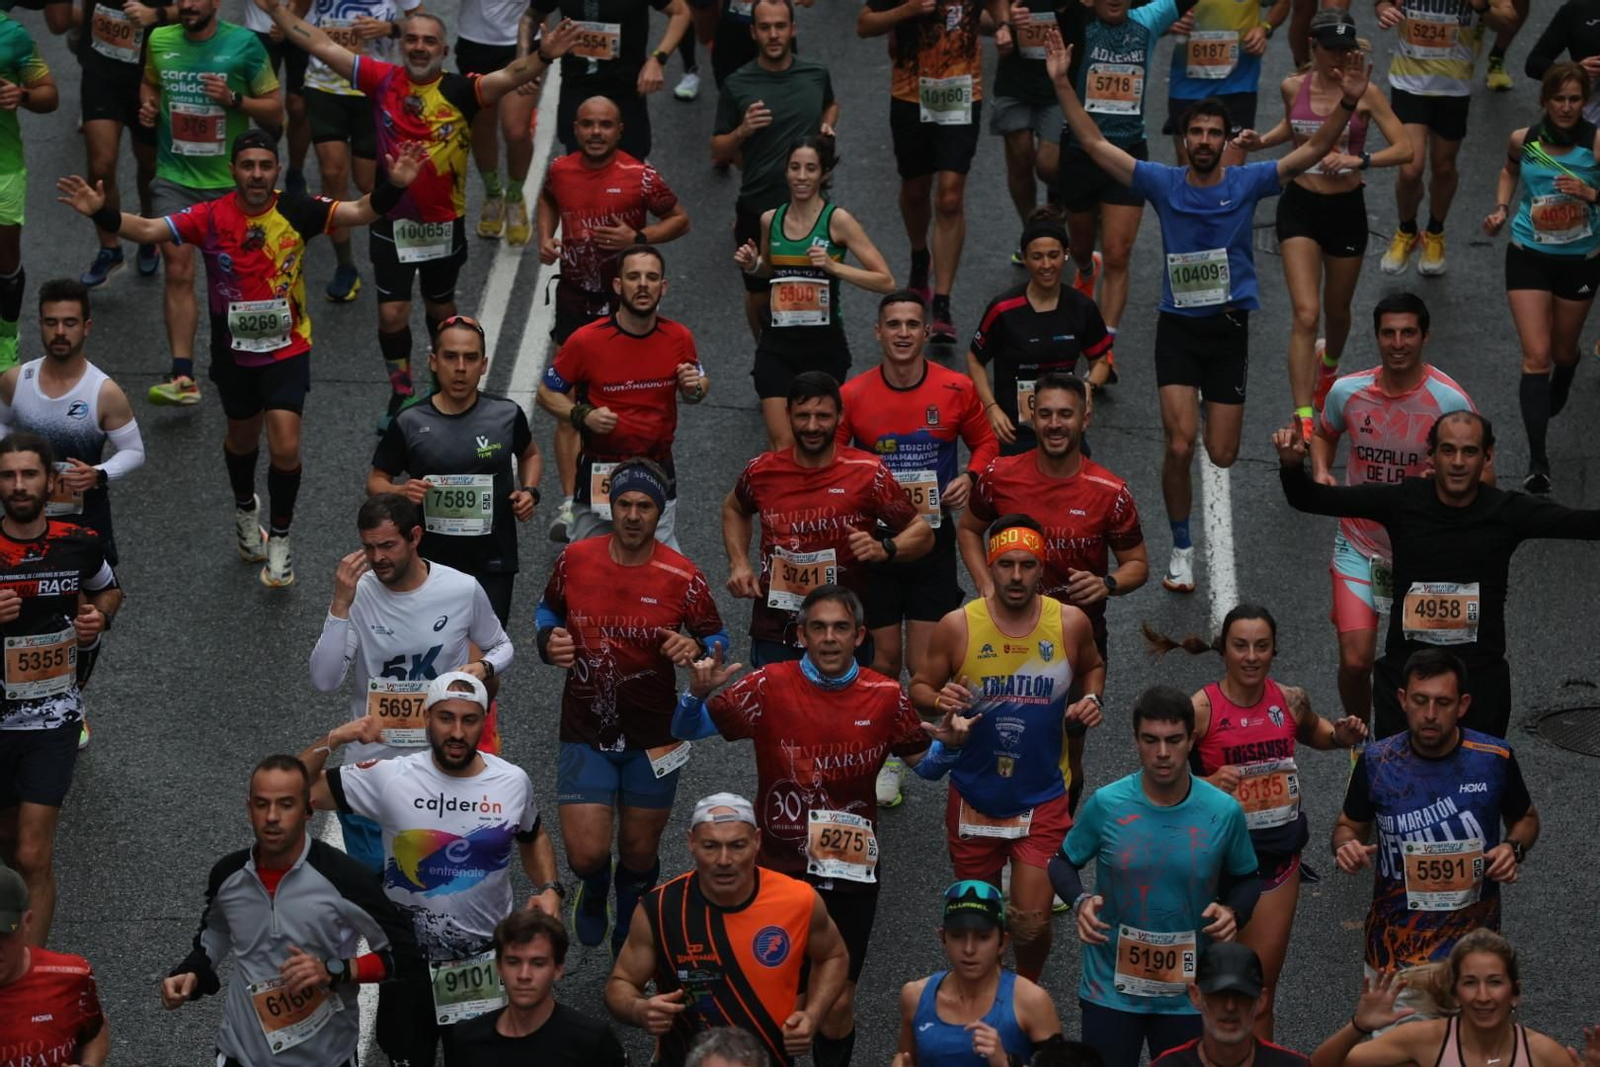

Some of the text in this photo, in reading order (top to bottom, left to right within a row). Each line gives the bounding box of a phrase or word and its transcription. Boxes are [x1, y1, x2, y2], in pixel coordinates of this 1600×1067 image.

[98, 17, 131, 41] 3690
[1413, 23, 1446, 40] 5234
[1192, 43, 1225, 58] 6187
[1096, 76, 1130, 93] 5718
[924, 88, 963, 105] 10160
[182, 117, 208, 136] 376
[400, 223, 444, 240] 10065
[1173, 263, 1220, 285] 10409
[238, 313, 278, 333] 8269
[1357, 445, 1418, 467] CAZALLA
[1367, 464, 1405, 483] DE LA
[433, 490, 476, 509] 7589
[782, 564, 819, 586] 3741
[38, 577, 79, 595] RACE
[1414, 599, 1461, 619] 4958
[18, 647, 65, 672] 5355
[381, 644, 443, 681] 5K
[379, 698, 424, 718] 5697
[1239, 775, 1284, 802] 6135
[1458, 782, 1488, 794] HOKA
[413, 792, 502, 818] calderón
[772, 790, 802, 822] 30
[1396, 796, 1459, 834] MARATÓN
[820, 827, 864, 853] 5275
[429, 864, 486, 878] entrénate
[1417, 858, 1465, 880] 5591
[1129, 946, 1177, 970] 5190
[445, 964, 493, 992] 9101
